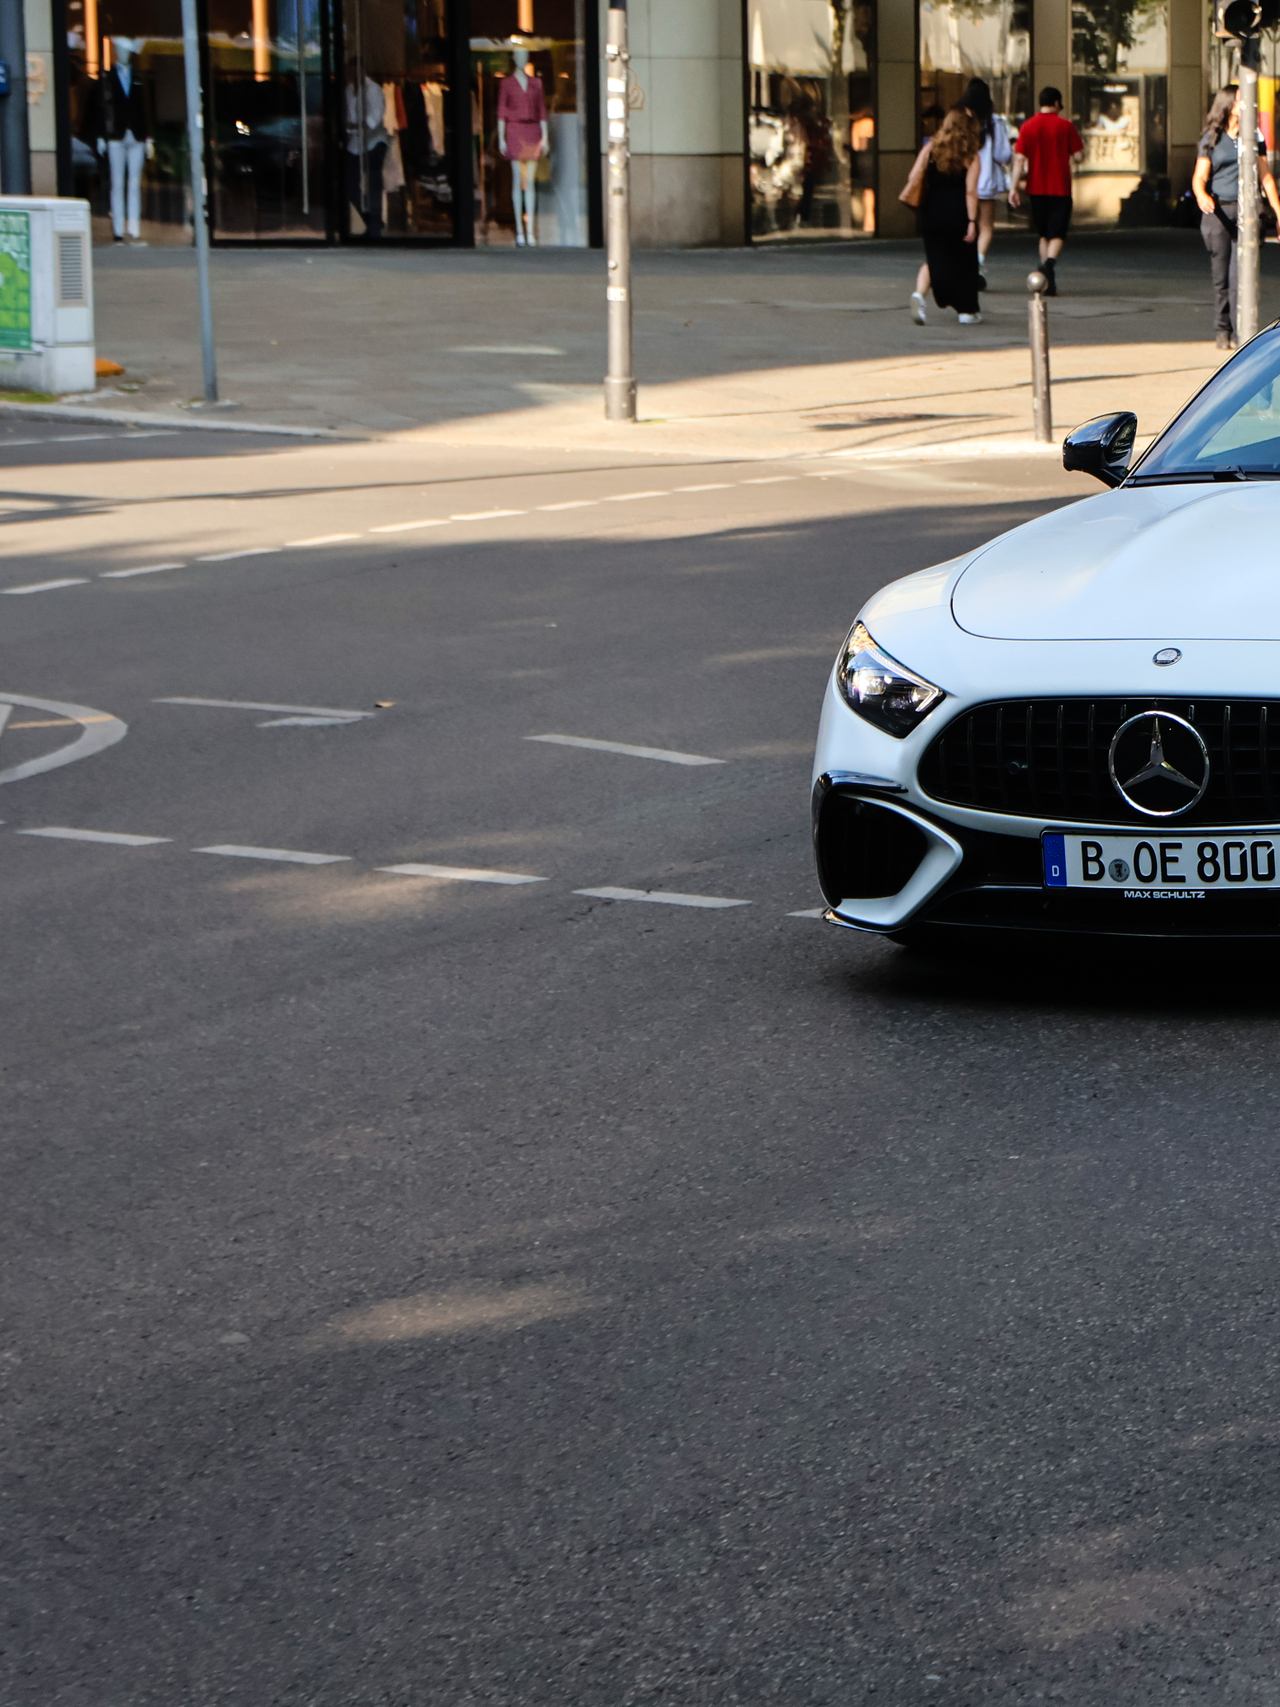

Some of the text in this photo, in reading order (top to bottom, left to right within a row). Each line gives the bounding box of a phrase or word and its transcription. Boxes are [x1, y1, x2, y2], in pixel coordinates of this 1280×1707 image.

[1080, 840, 1106, 882] B
[1133, 840, 1187, 884] OE
[1196, 840, 1277, 883] 800
[1051, 864, 1060, 878] D
[1124, 890, 1206, 899] MAX SCHULTZ
